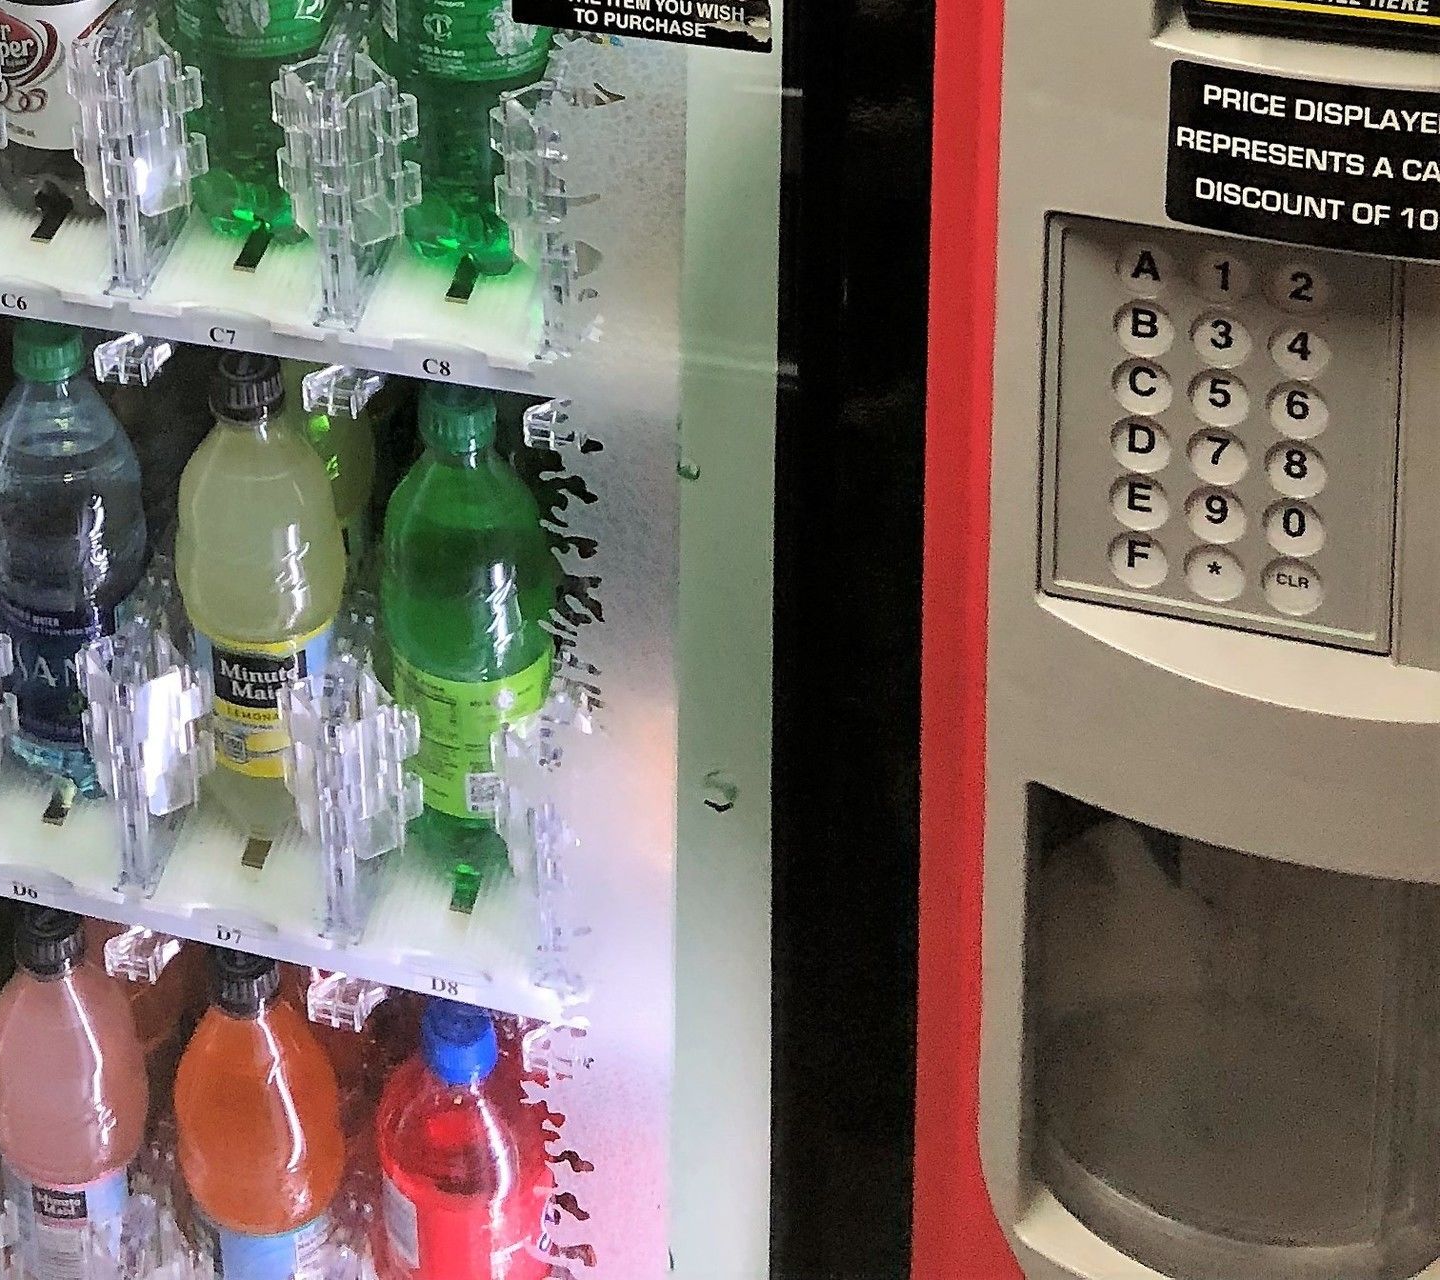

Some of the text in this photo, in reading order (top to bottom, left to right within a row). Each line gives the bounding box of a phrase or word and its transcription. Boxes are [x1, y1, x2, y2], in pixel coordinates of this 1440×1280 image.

[574, 8, 707, 39] TO PURCHASE
[695, 3, 745, 22] WISH
[1204, 85, 1286, 117] PRICE
[1177, 126, 1365, 176] REPRESENTS
[1372, 157, 1394, 179] A
[1196, 178, 1439, 230] DISCOUNT OF 10
[1131, 251, 1160, 281] A
[1215, 262, 1230, 291] 1
[1289, 273, 1313, 302] 2
[1, 293, 27, 311] C6
[209, 326, 236, 344] C7
[1131, 310, 1158, 338] B
[1210, 320, 1233, 350] 3
[1287, 332, 1311, 360] 4
[422, 358, 451, 376] C8
[1129, 367, 1157, 397] C
[1209, 379, 1231, 408] 5
[1287, 392, 1309, 420] 6
[1129, 425, 1155, 454] D
[1208, 439, 1230, 466] 7
[1285, 450, 1307, 478] 8
[1128, 483, 1152, 511] E
[1206, 495, 1228, 524] 9
[1283, 508, 1306, 538] 0
[1128, 541, 1150, 568] F
[1276, 573, 1309, 589] CLR
[221, 659, 299, 682] Minute
[231, 680, 276, 700] Mai
[12, 882, 38, 898] D6
[216, 924, 242, 943] D7
[431, 977, 458, 996] D8
